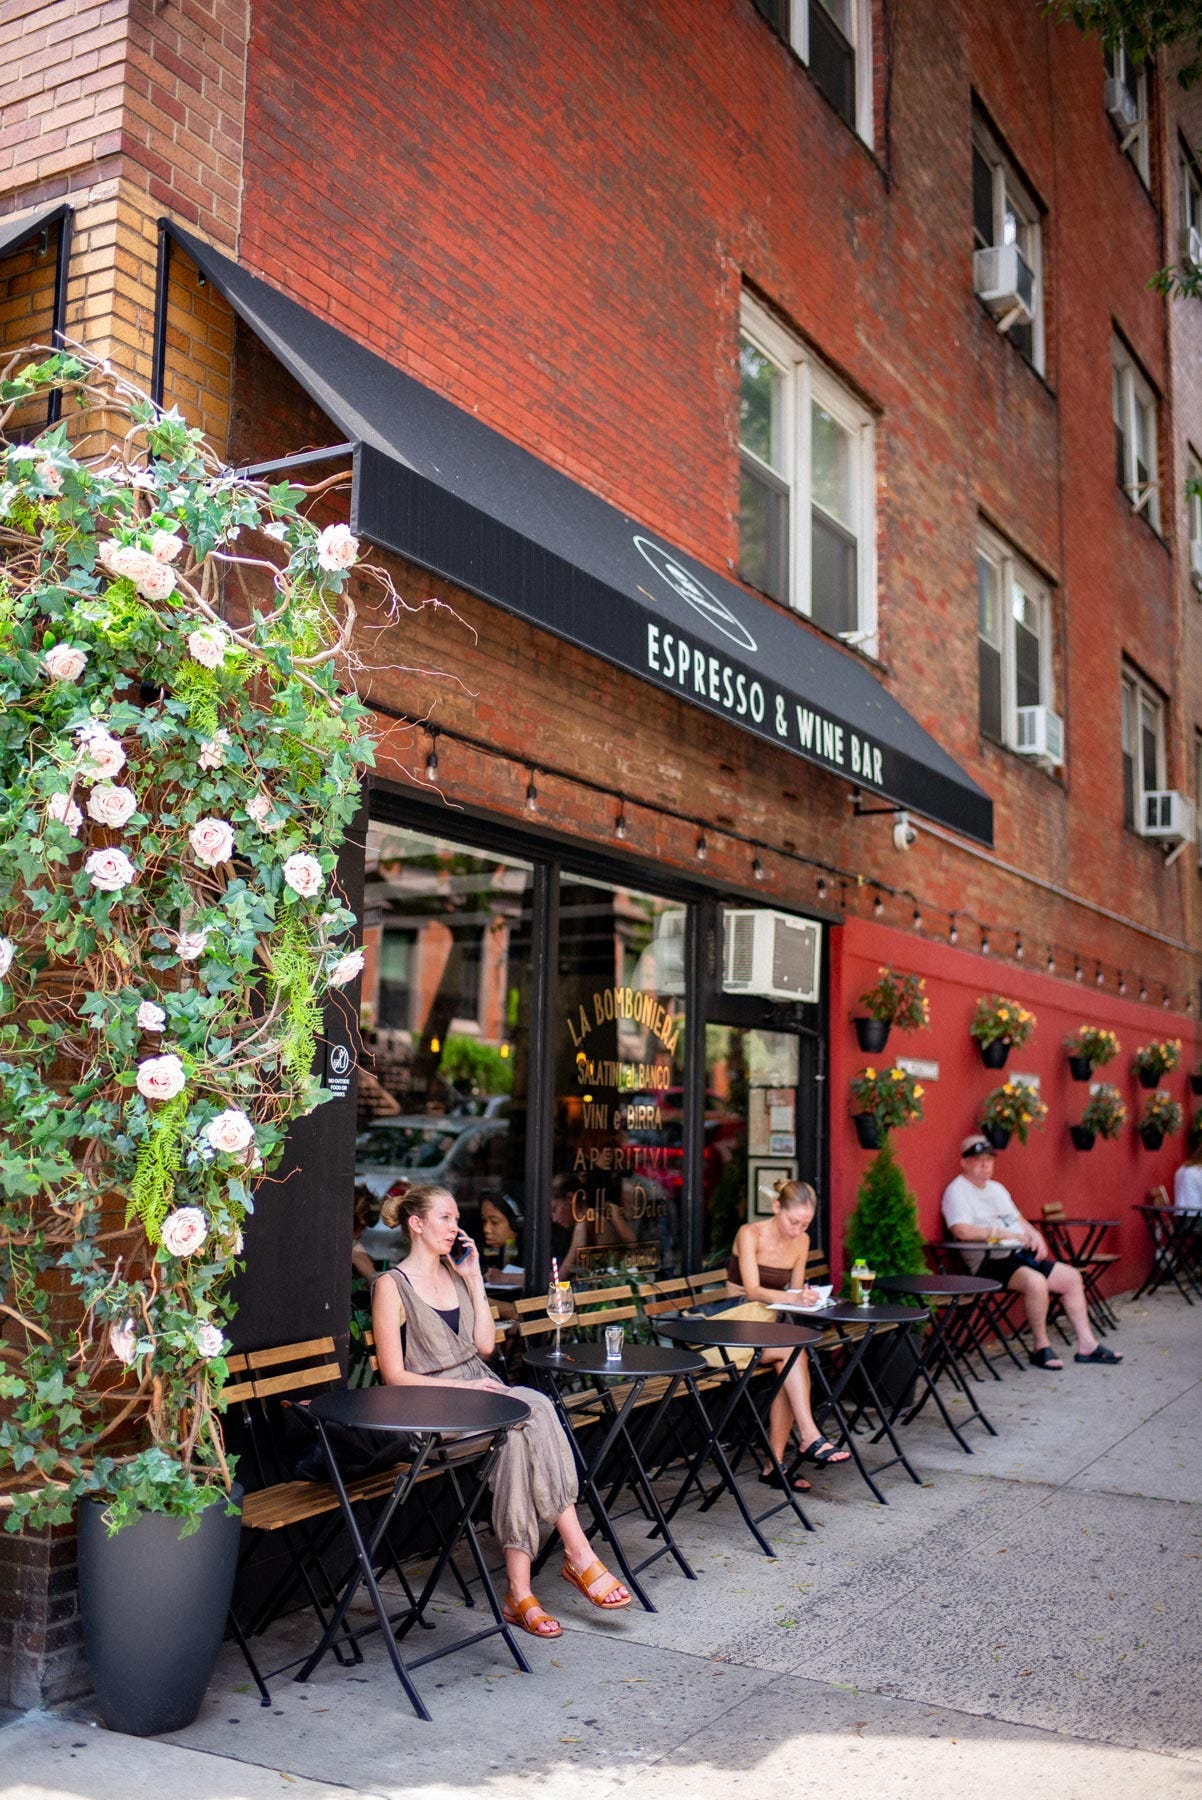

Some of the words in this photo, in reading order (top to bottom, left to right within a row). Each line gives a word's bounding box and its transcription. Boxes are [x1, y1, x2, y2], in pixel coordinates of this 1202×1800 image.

[647, 623, 765, 724] ESPRESSO
[775, 694, 788, 737] &
[796, 705, 844, 765] WINE
[850, 734, 884, 786] BAR
[567, 1004, 592, 1048] LA
[593, 986, 681, 1057] BOMBONIERA
[577, 1060, 623, 1088] SALATINI
[639, 1062, 671, 1091] BANCO
[583, 1103, 609, 1130] VINI
[613, 1113, 622, 1131] e
[627, 1104, 663, 1131] BIRRA
[574, 1146, 668, 1171] APERITIVI
